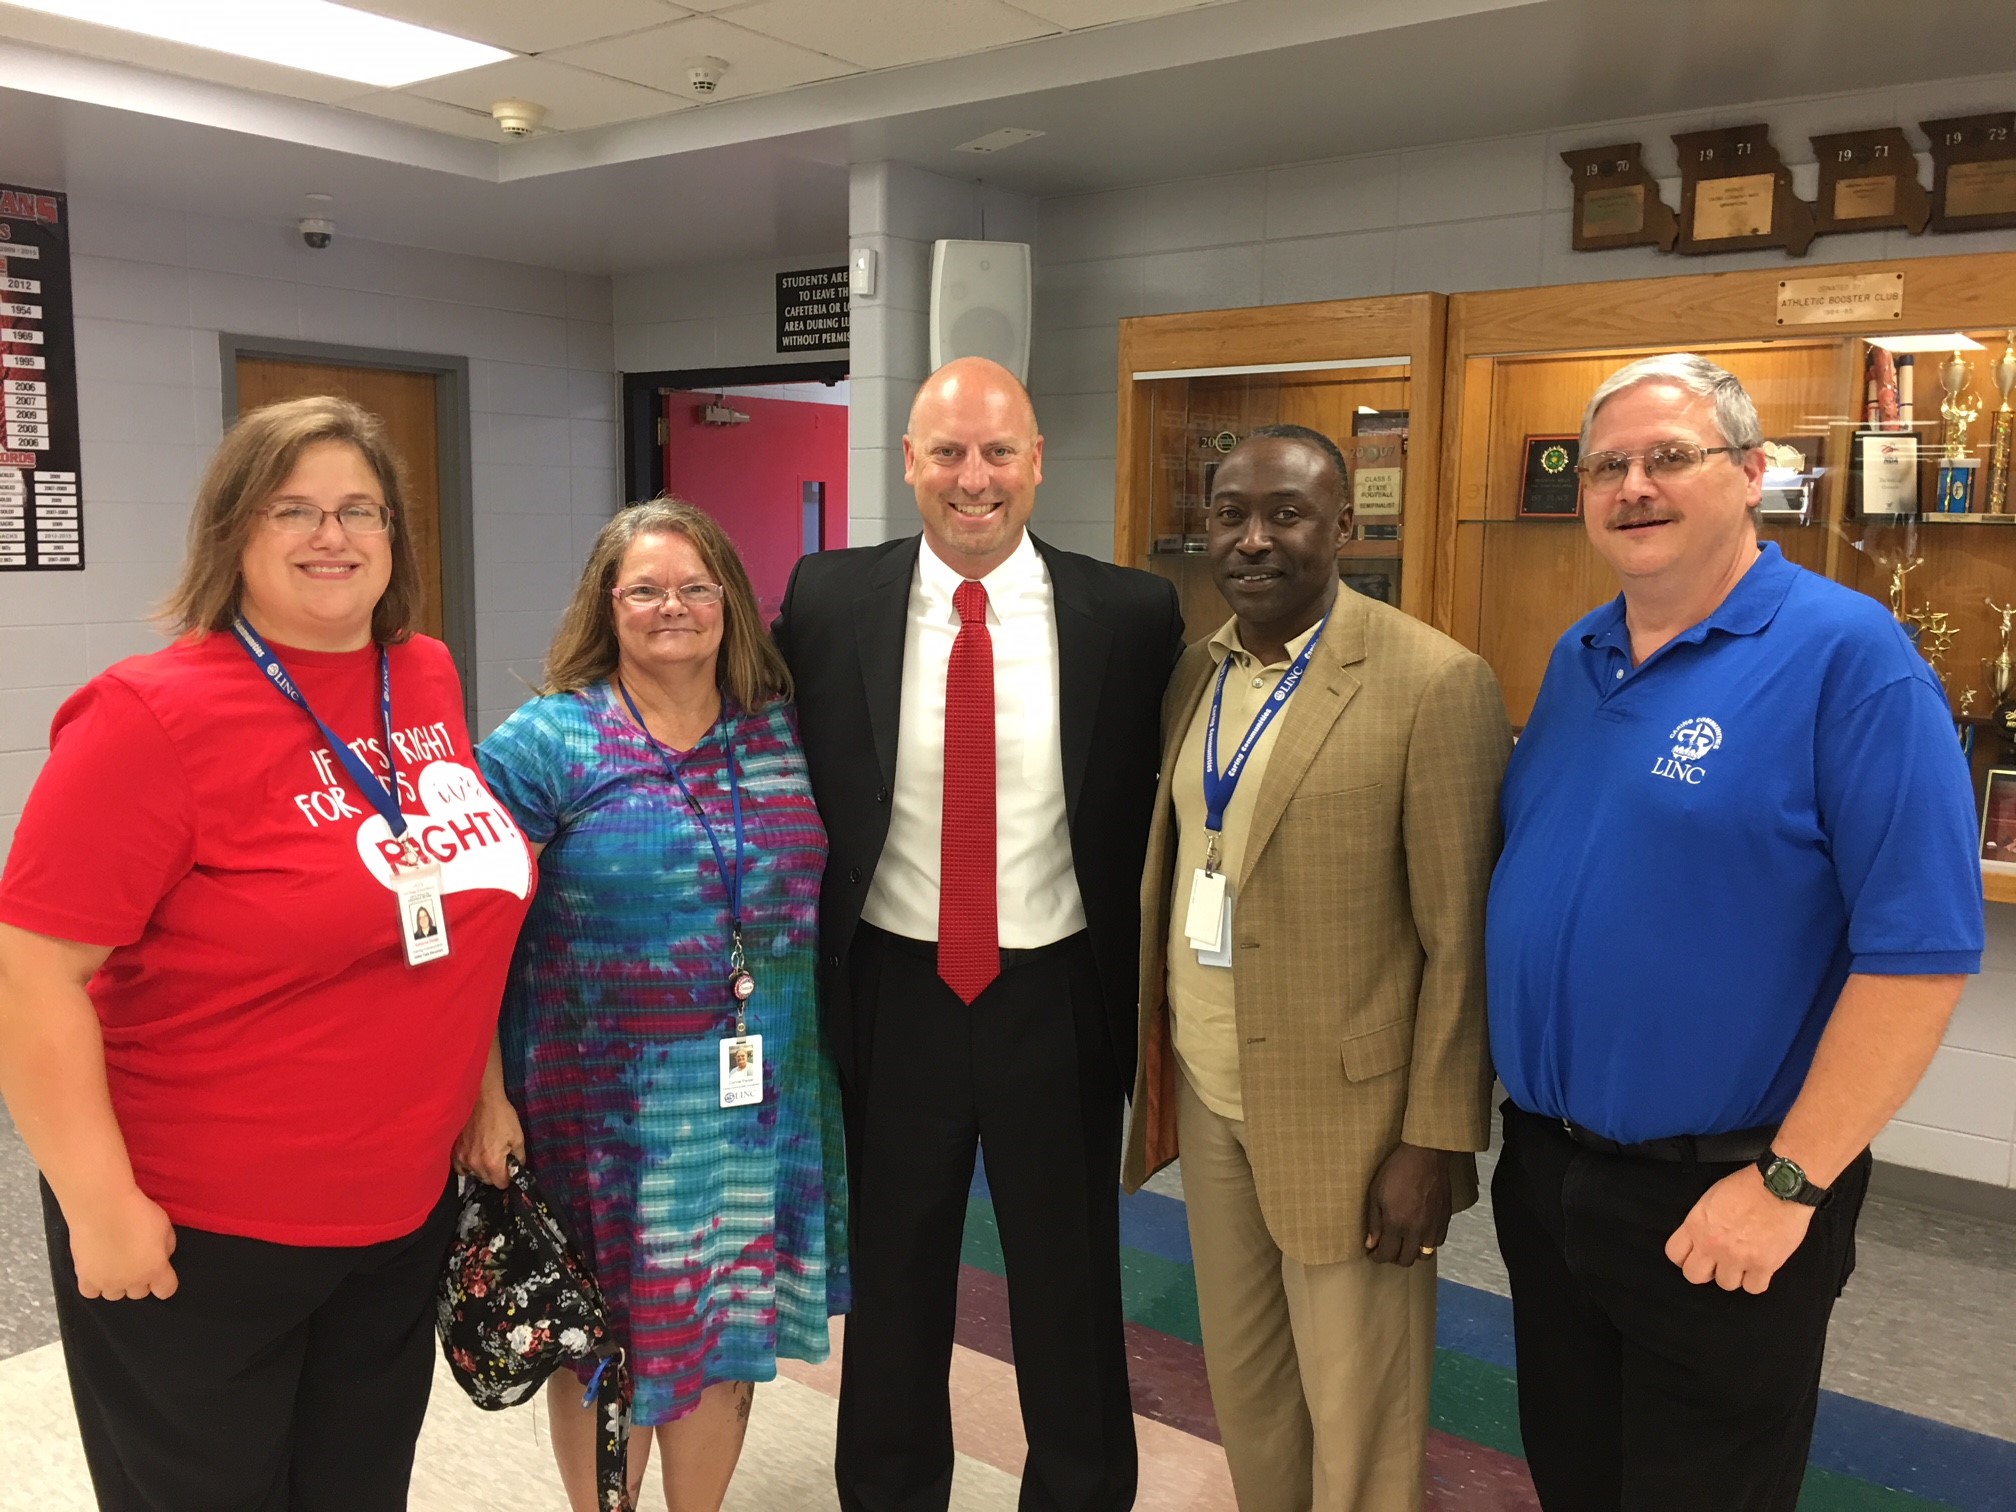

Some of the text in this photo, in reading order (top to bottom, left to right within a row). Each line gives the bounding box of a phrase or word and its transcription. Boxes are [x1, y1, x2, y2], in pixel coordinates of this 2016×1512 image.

[1945, 128, 2008, 146] 19 72
[1700, 143, 1751, 162] 19 71
[1838, 145, 1889, 162] 19 71
[1586, 160, 1630, 176] 19 70
[8, 279, 32, 290] 2012
[782, 271, 848, 288] STUDENTS ARE
[799, 291, 810, 302] TO
[812, 288, 835, 300] LEAVE
[1781, 292, 1899, 307] ATHLETIC BOOSTER CLUB
[11, 305, 32, 316] 1954
[784, 304, 827, 318] CAFETERIA
[829, 302, 840, 314] OR
[784, 320, 804, 332] AREA
[806, 318, 838, 330] DURING
[12, 331, 33, 341] 1969
[782, 334, 820, 346] WITHOUT
[14, 356, 35, 367] 1995
[15, 382, 36, 392] 2006
[16, 396, 36, 406] 2007
[16, 410, 37, 420] 2009
[17, 424, 38, 434] 2008
[18, 438, 39, 448] 2006
[273, 671, 300, 700] LINC
[1283, 666, 1303, 692] LINC
[1228, 708, 1272, 777] Caring Communities
[310, 748, 337, 786] IF
[347, 737, 390, 774] T'S
[391, 722, 455, 764] RIGHT
[1651, 756, 1706, 784] LINC
[294, 786, 362, 828] FOR
